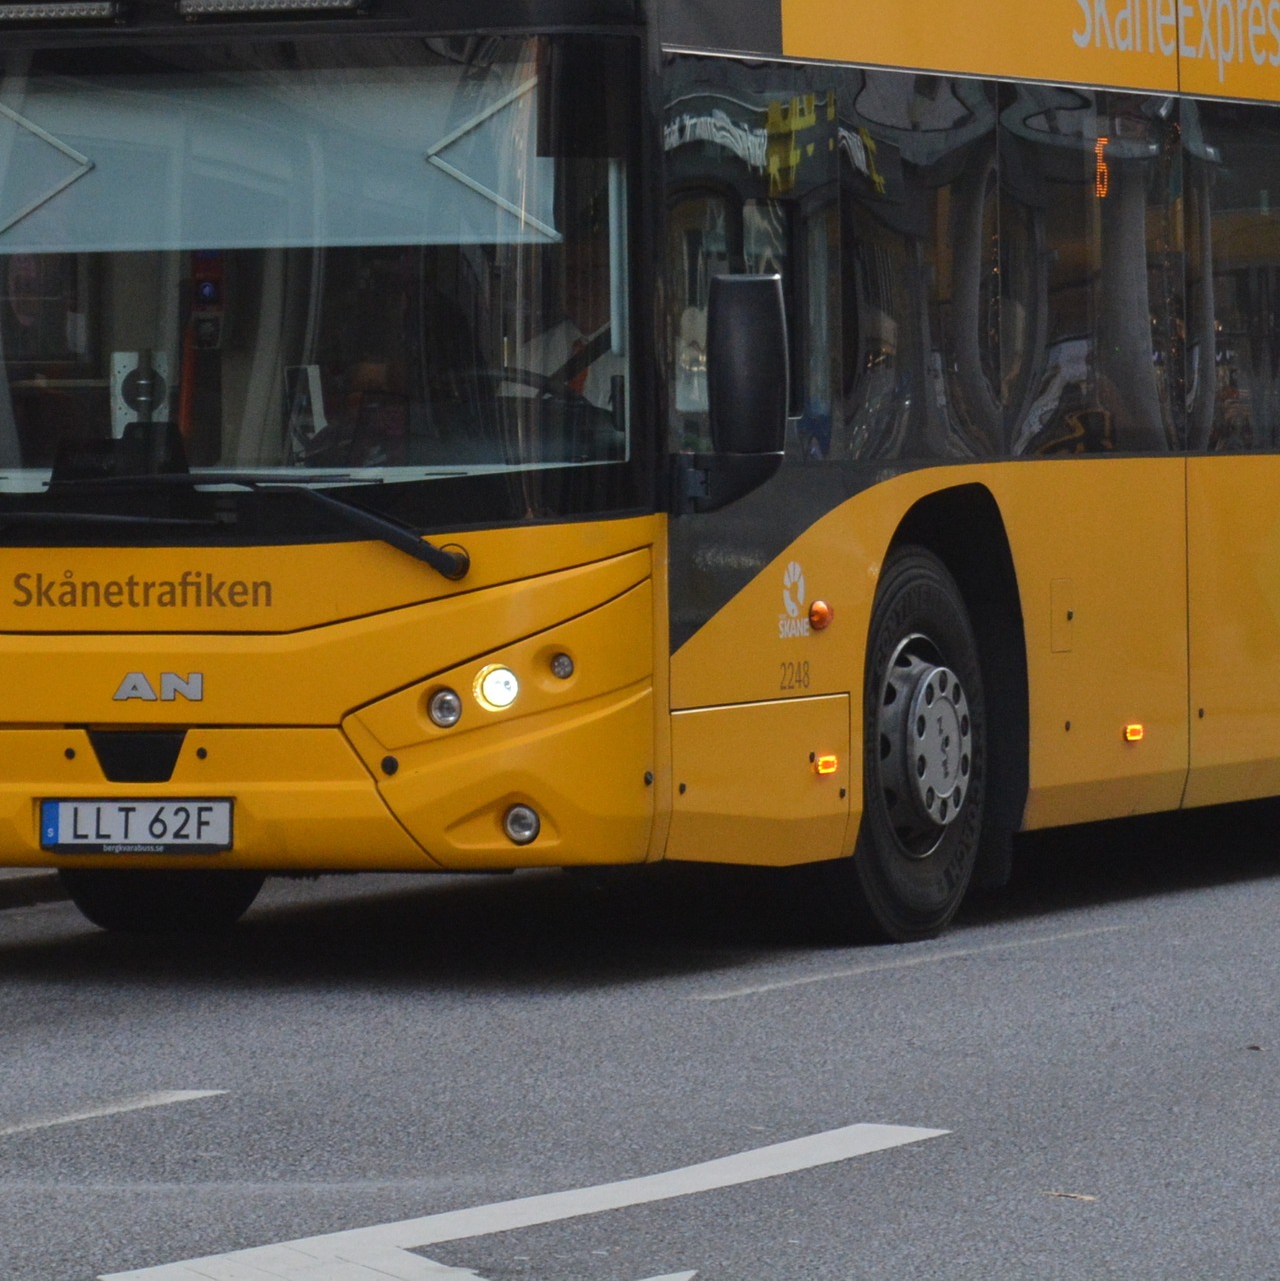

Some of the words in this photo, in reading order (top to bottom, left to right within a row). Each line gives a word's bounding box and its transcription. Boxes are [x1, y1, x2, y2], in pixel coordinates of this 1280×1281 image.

[12, 569, 273, 608] Skånetrafiken
[113, 672, 204, 702] AN
[779, 660, 810, 690] 2248
[46, 827, 55, 838] S
[72, 806, 136, 840] LLT
[148, 806, 213, 840] 62F
[102, 842, 164, 854] bergkvarabuss.se
